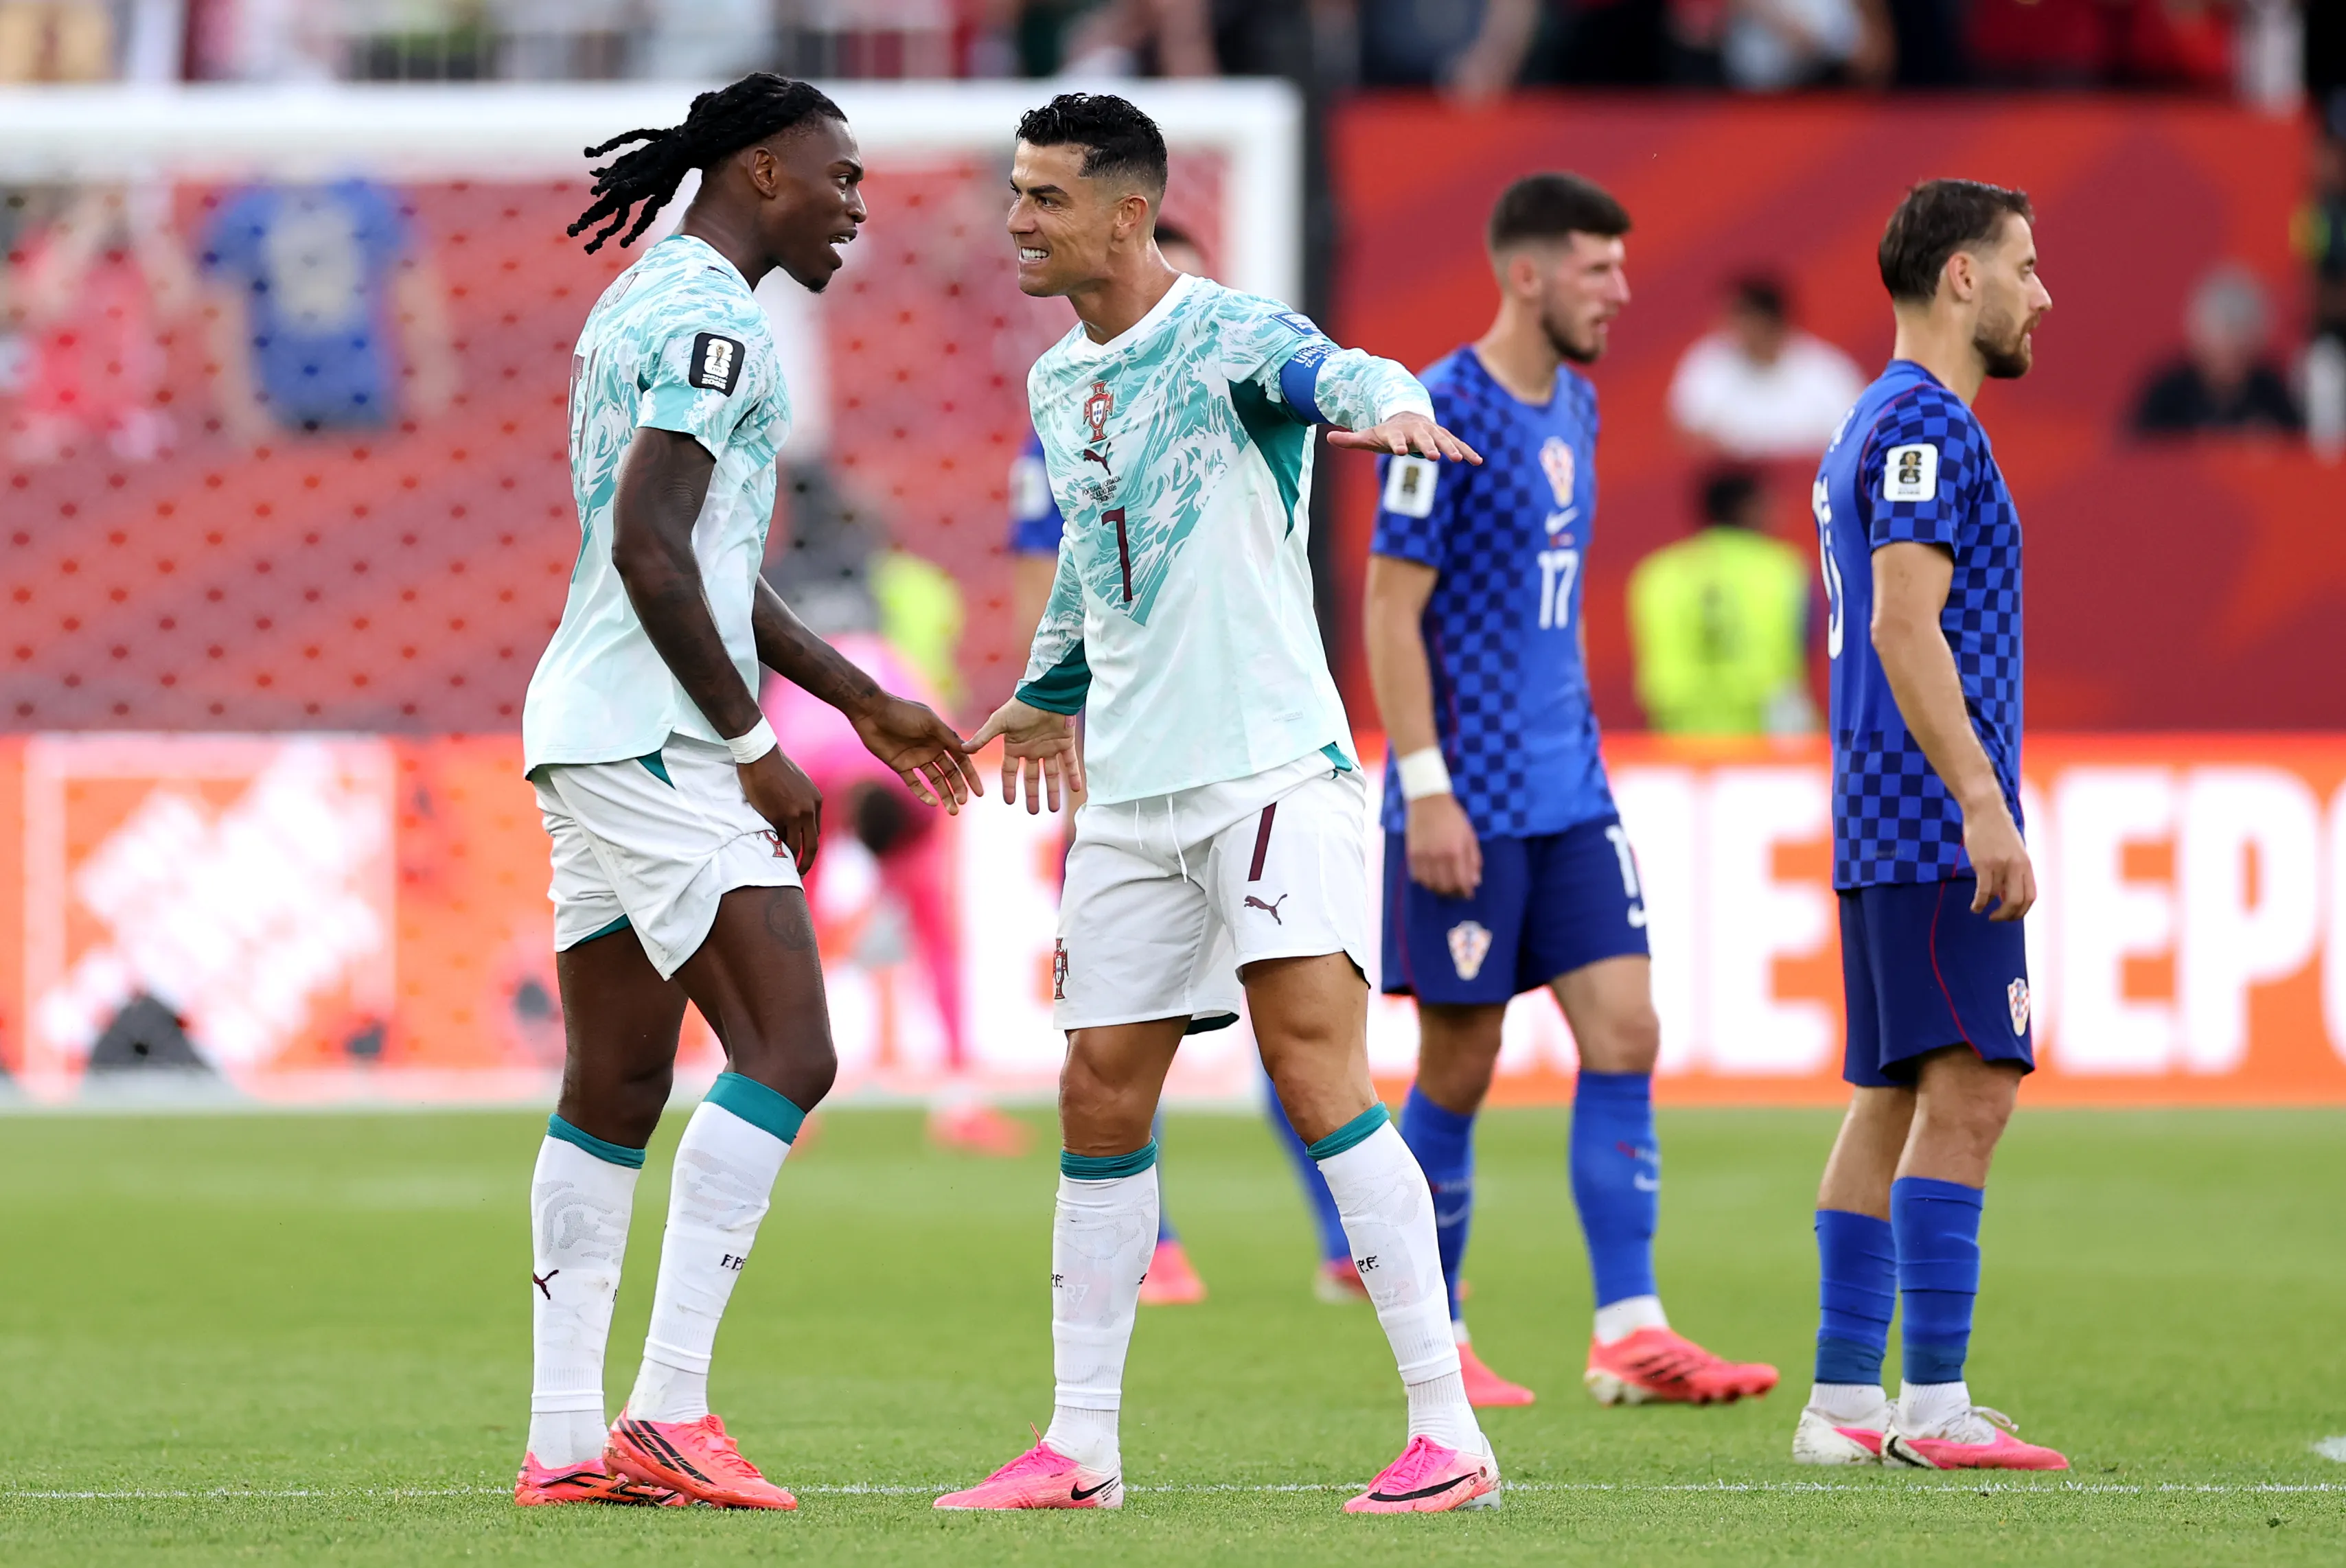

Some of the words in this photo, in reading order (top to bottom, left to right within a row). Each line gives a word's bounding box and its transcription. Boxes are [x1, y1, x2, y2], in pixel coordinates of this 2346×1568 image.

[1096, 492, 1114, 505] TORONTO
[1537, 550, 1579, 630] 17
[2022, 763, 2346, 1079] EP
[1469, 1475, 1479, 1486] CR7
